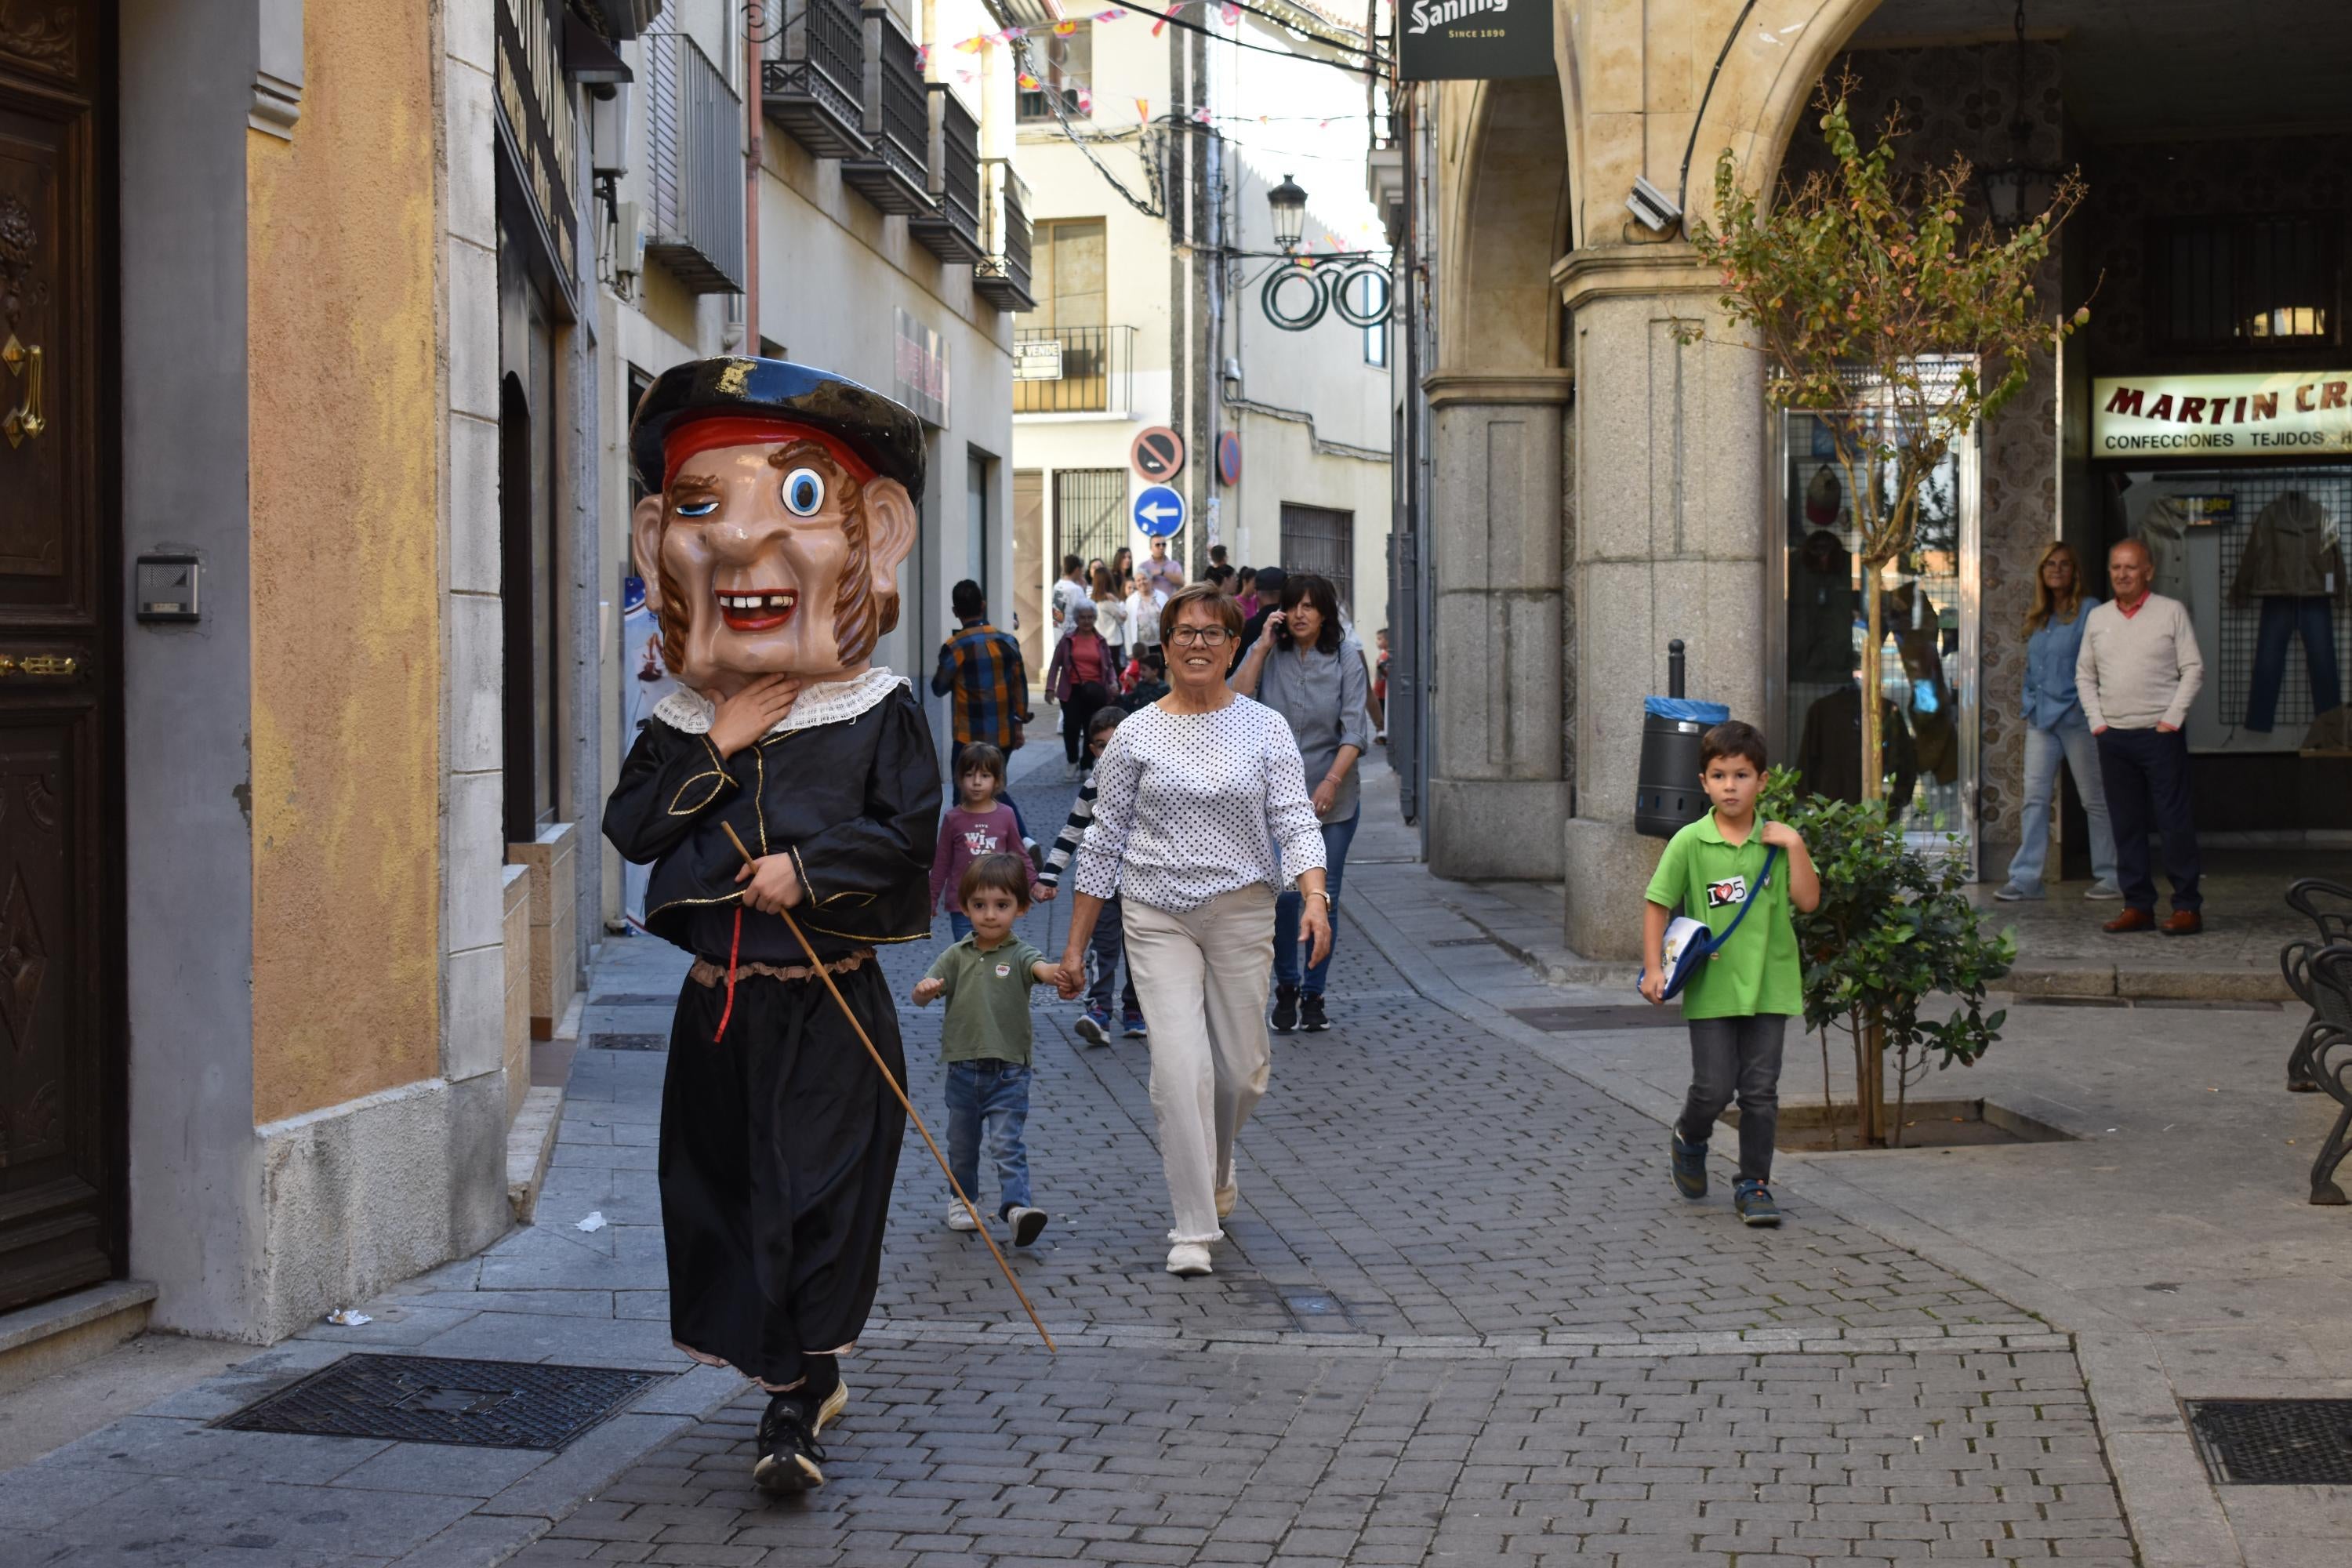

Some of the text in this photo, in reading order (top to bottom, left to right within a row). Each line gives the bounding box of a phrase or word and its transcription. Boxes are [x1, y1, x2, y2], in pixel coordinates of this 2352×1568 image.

[1448, 29, 1505, 38] SINCE 1890
[1025, 343, 1059, 358] VENDE
[2104, 380, 2352, 425] MARTIN CR
[2105, 434, 2234, 449] CONFECCIONES
[2249, 431, 2325, 446] TEJIDOS
